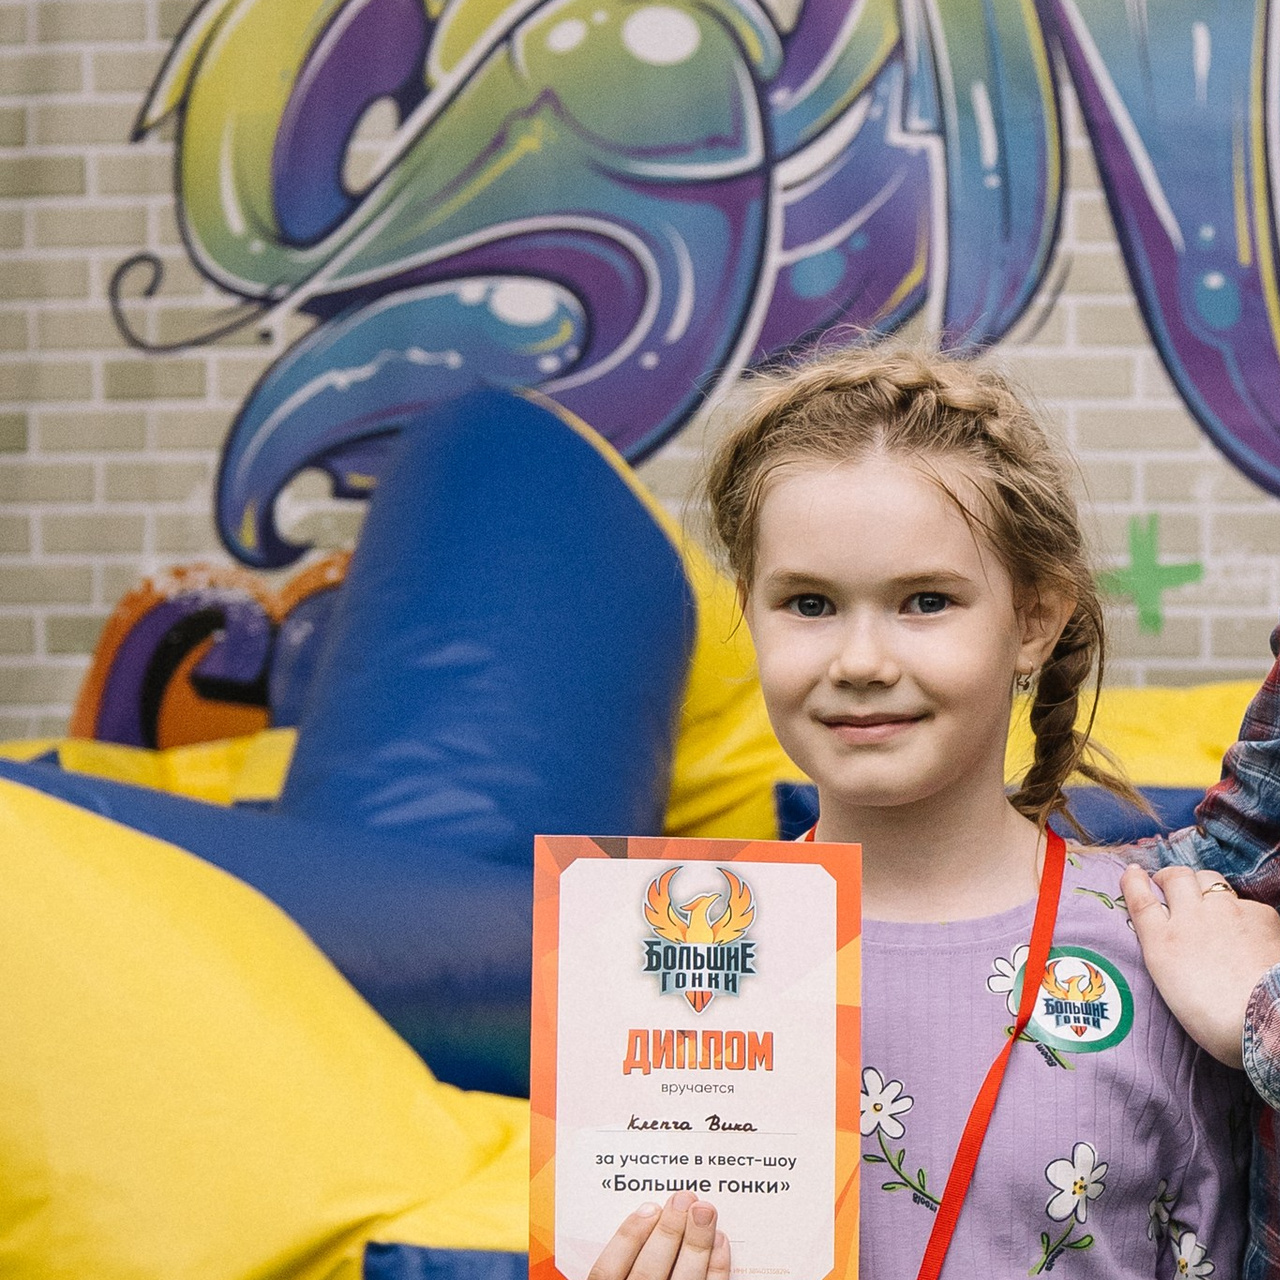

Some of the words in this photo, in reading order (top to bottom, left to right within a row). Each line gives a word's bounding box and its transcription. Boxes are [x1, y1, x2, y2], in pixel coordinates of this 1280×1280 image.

[643, 940, 757, 974] БОЛЬШИЕ
[661, 971, 738, 994] ГОНКИ
[622, 1029, 774, 1075] ДИПЛОМ
[661, 1083, 735, 1096] вручается
[705, 1114, 758, 1132] Вика
[595, 1154, 614, 1165] за
[620, 1154, 689, 1168] участие
[694, 1154, 703, 1165] в
[708, 1155, 797, 1170] квест-шоу
[601, 1174, 711, 1192] «Большие
[718, 1179, 790, 1194] гонки»
